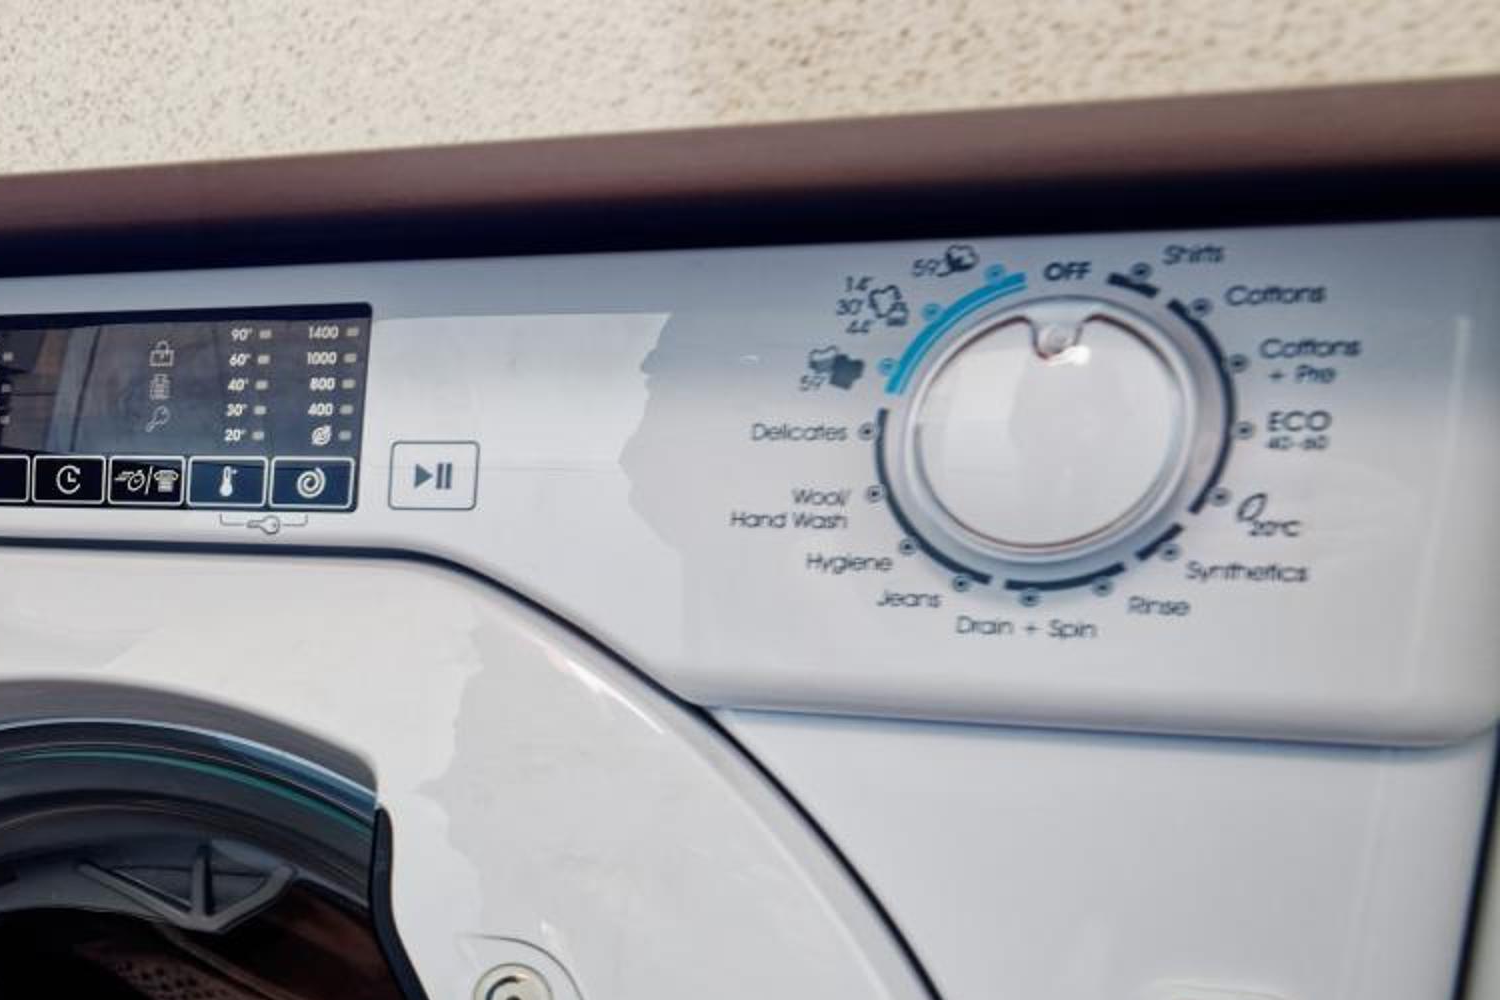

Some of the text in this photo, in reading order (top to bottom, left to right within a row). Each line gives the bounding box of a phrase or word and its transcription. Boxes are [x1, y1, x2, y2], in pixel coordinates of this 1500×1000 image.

[1162, 244, 1226, 265] Shirts
[1044, 261, 1091, 282] OFF
[1224, 284, 1327, 306] Cottons
[308, 325, 339, 340] 1400
[1259, 337, 1362, 359] Cottons
[307, 352, 338, 366] 1000
[309, 377, 336, 391] 800
[307, 403, 334, 417] 400
[1266, 409, 1333, 432] ECO
[751, 422, 849, 442] Delicates
[731, 511, 849, 530] Hand Wash
[805, 553, 894, 576] Hygiene
[1186, 560, 1310, 584] Synthetics
[876, 591, 942, 609] Jeans
[1127, 596, 1192, 617] Rinse
[955, 614, 1015, 636] Drain
[1048, 618, 1099, 640] Spin
